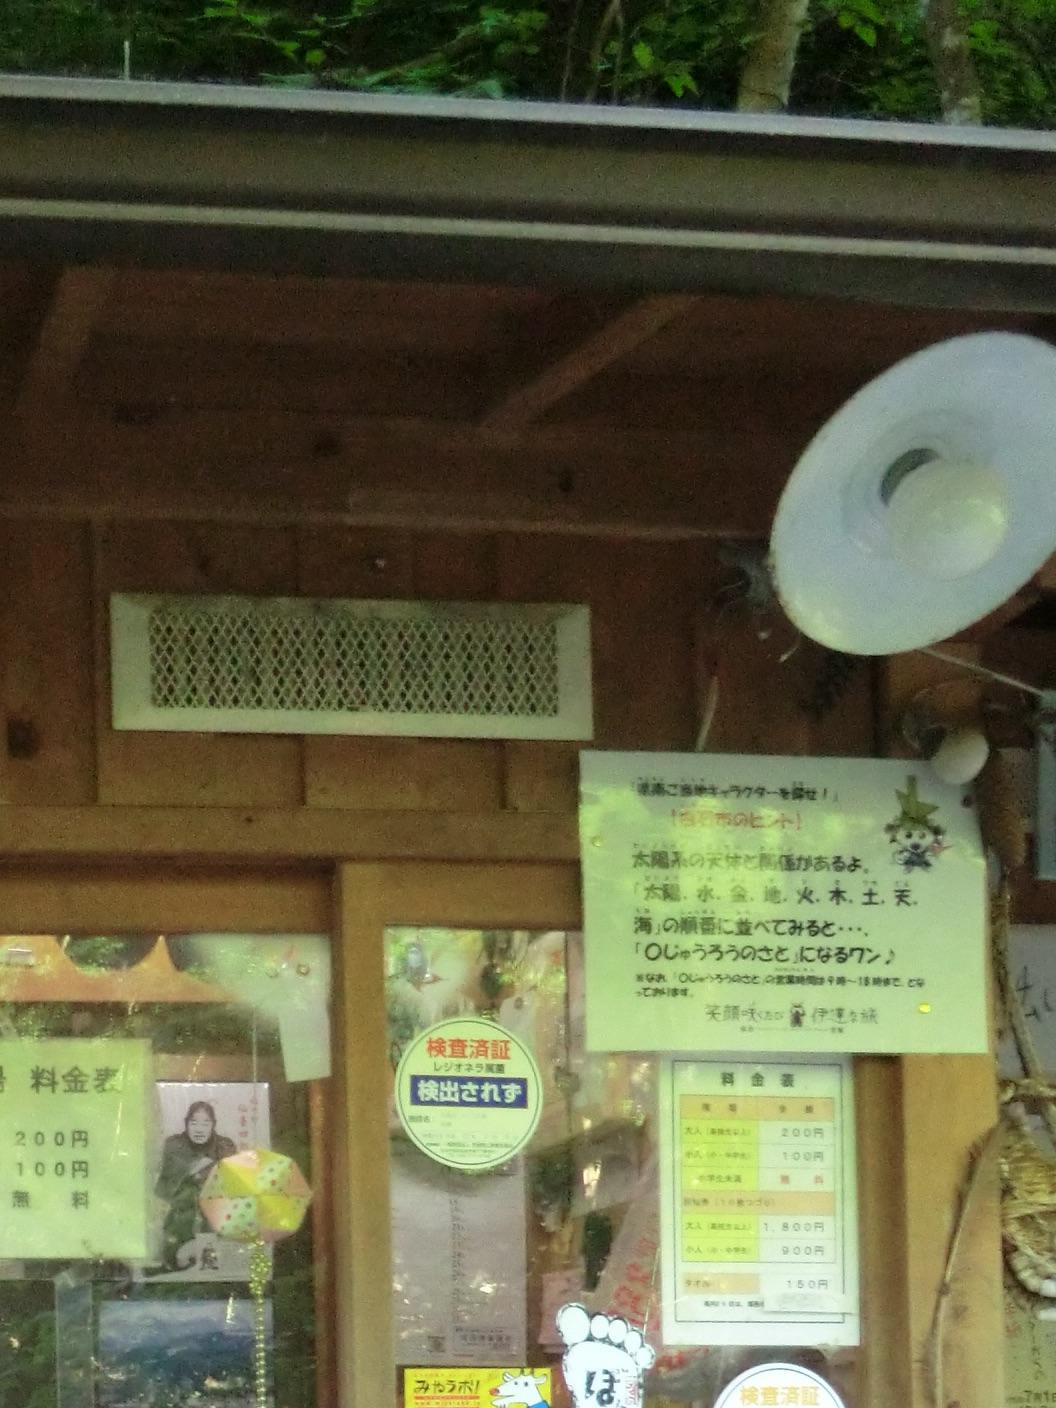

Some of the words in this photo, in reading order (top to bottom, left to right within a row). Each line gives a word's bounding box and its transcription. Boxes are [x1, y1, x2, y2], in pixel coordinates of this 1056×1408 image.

[426, 1037, 512, 1060] 検査済証
[30, 1065, 123, 1094] 料金表
[417, 1080, 522, 1103] 検出されず
[15, 1129, 89, 1149] 200円
[16, 1160, 89, 1179] 100円
[739, 1386, 820, 1407] 検査済証
